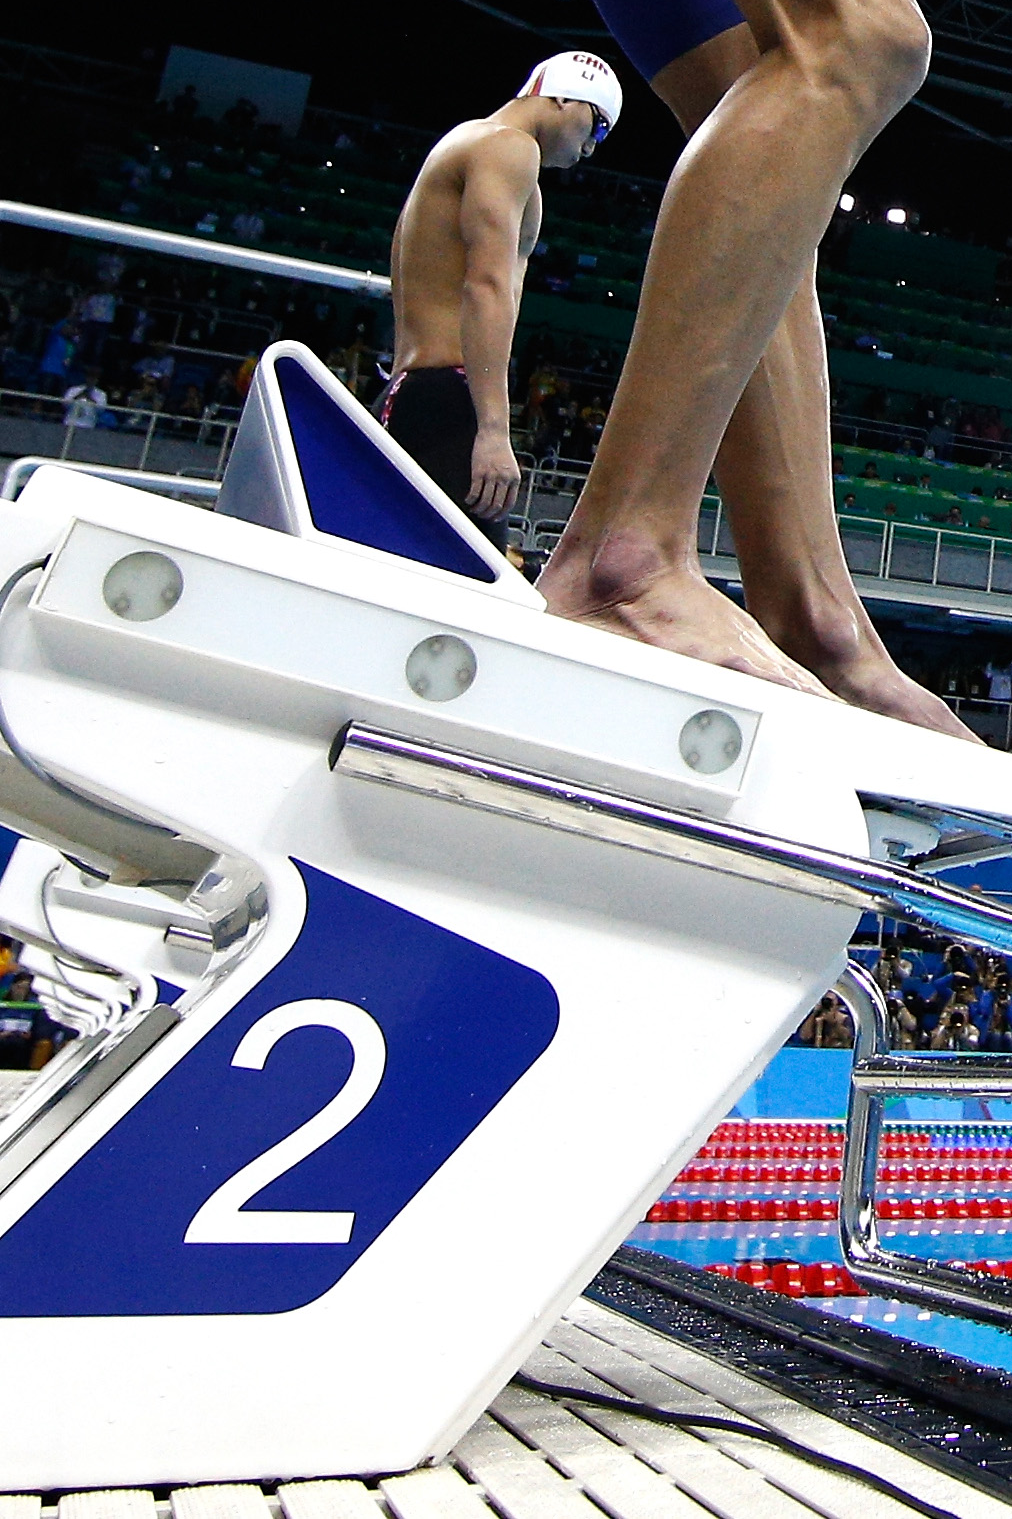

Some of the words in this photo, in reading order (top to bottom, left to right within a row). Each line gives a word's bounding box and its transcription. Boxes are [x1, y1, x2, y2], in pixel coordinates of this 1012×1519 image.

[572, 54, 609, 76] CHN
[581, 70, 595, 82] LI
[183, 998, 388, 1244] 2
